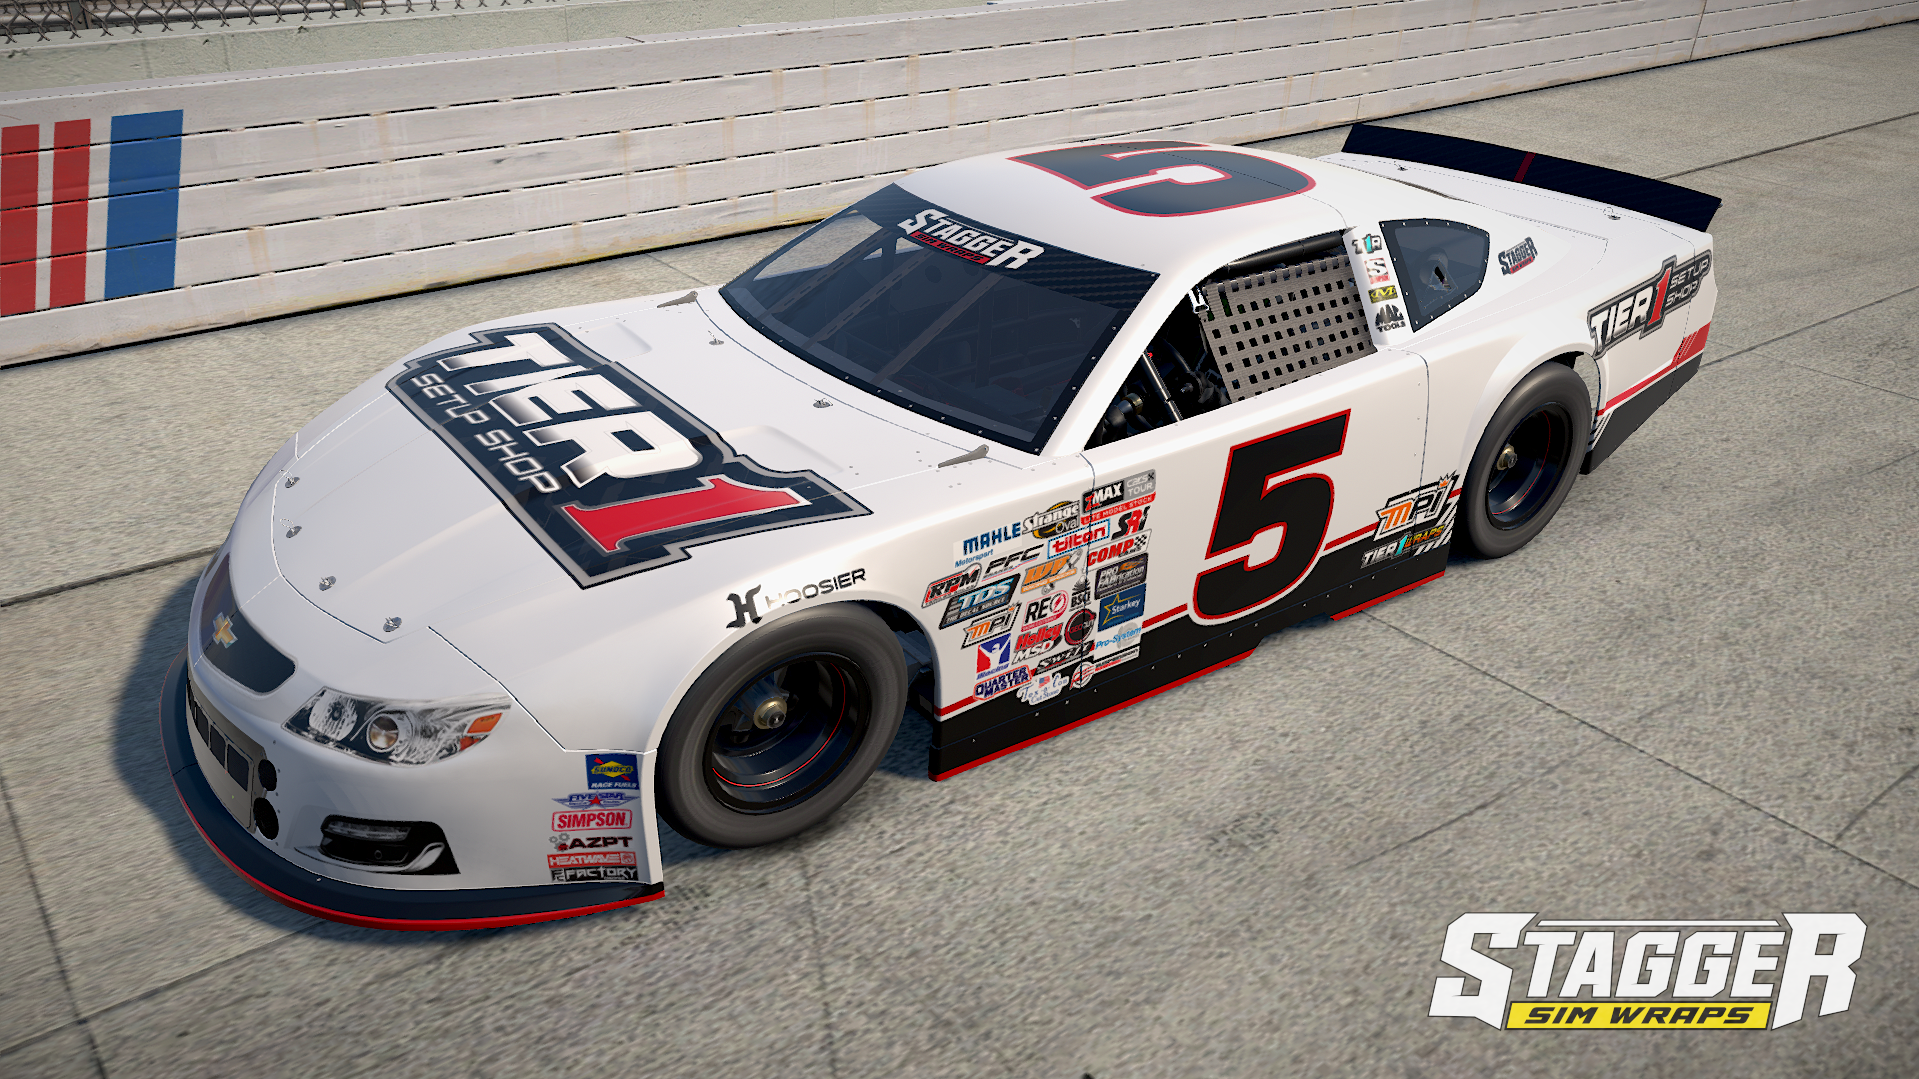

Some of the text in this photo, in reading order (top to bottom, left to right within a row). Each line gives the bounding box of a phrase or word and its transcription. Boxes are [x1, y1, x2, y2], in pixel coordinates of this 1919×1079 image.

[1005, 140, 1317, 217] 5
[897, 208, 1045, 269] STAGGER
[1669, 258, 1710, 290] SETUP
[1665, 280, 1699, 308] SHOP
[1376, 320, 1406, 332] TOOLS
[410, 372, 562, 494] SETUP SHOP
[1127, 482, 1153, 496] TOUR
[1022, 503, 1079, 535] Strange
[1056, 516, 1080, 533] Oval
[1192, 408, 1352, 620] 5
[963, 521, 1021, 556] MAHLE
[1052, 525, 1106, 553] tilton
[1088, 538, 1134, 567] COMP
[954, 549, 994, 568] Motorsport
[984, 543, 1045, 574] PFC
[929, 568, 981, 598] RPM
[958, 577, 1015, 611] TDS
[1112, 598, 1141, 614] Starkey
[1015, 623, 1063, 651] Holley
[975, 667, 1028, 697] QUARTER
[984, 674, 1030, 698] MASTER
[592, 765, 633, 774] SUNOCO
[557, 811, 626, 829] SIMPSON
[568, 836, 633, 850] AZPT
[549, 853, 620, 866] HEATWAVE
[565, 866, 637, 880] FACTORY
